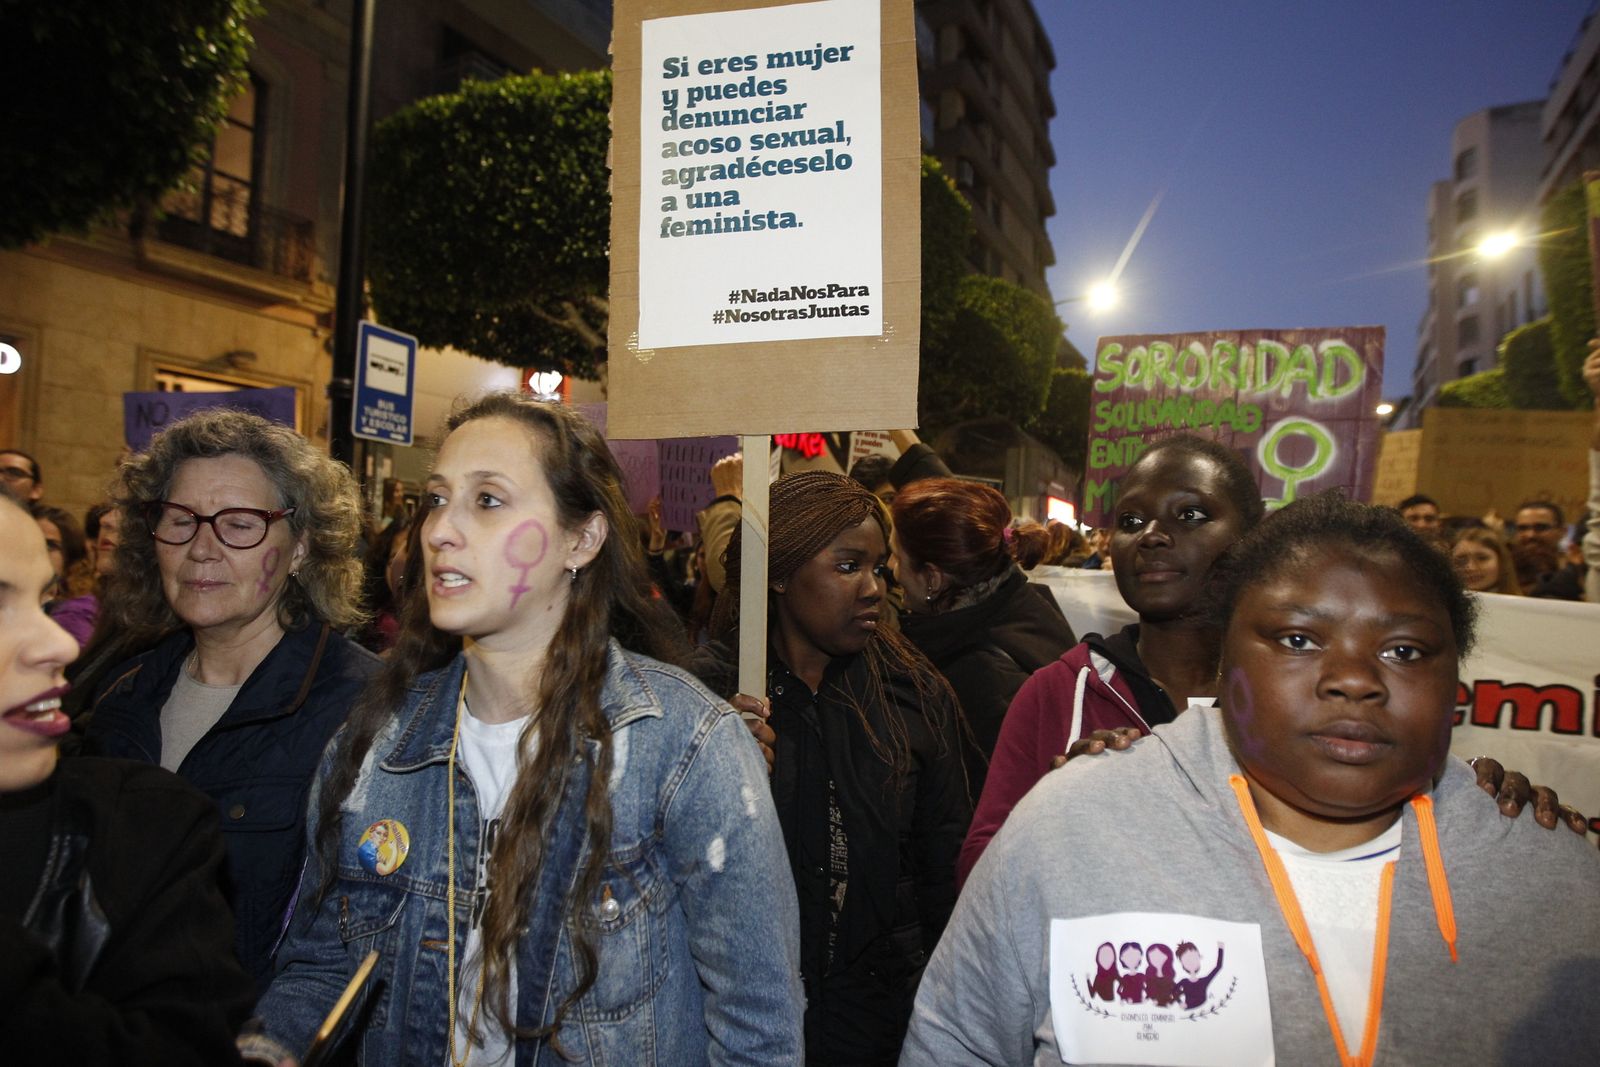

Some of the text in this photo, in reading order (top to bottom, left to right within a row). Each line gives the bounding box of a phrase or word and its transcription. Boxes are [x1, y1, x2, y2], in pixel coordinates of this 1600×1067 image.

[662, 43, 854, 79] Si eres mujer
[662, 76, 787, 111] y puedes
[661, 101, 808, 132] denunciar
[661, 121, 851, 159] acoso sexual,
[661, 149, 853, 190] agradéceselo
[661, 189, 740, 213] a una
[660, 210, 803, 239] feminista.
[728, 283, 870, 304] #NadaNosPara
[712, 304, 870, 324] #NosotrasJuntas
[1094, 339, 1367, 399] SORORIDAD
[136, 401, 170, 428] NO
[1094, 395, 1264, 434] SOLIDARIDAD
